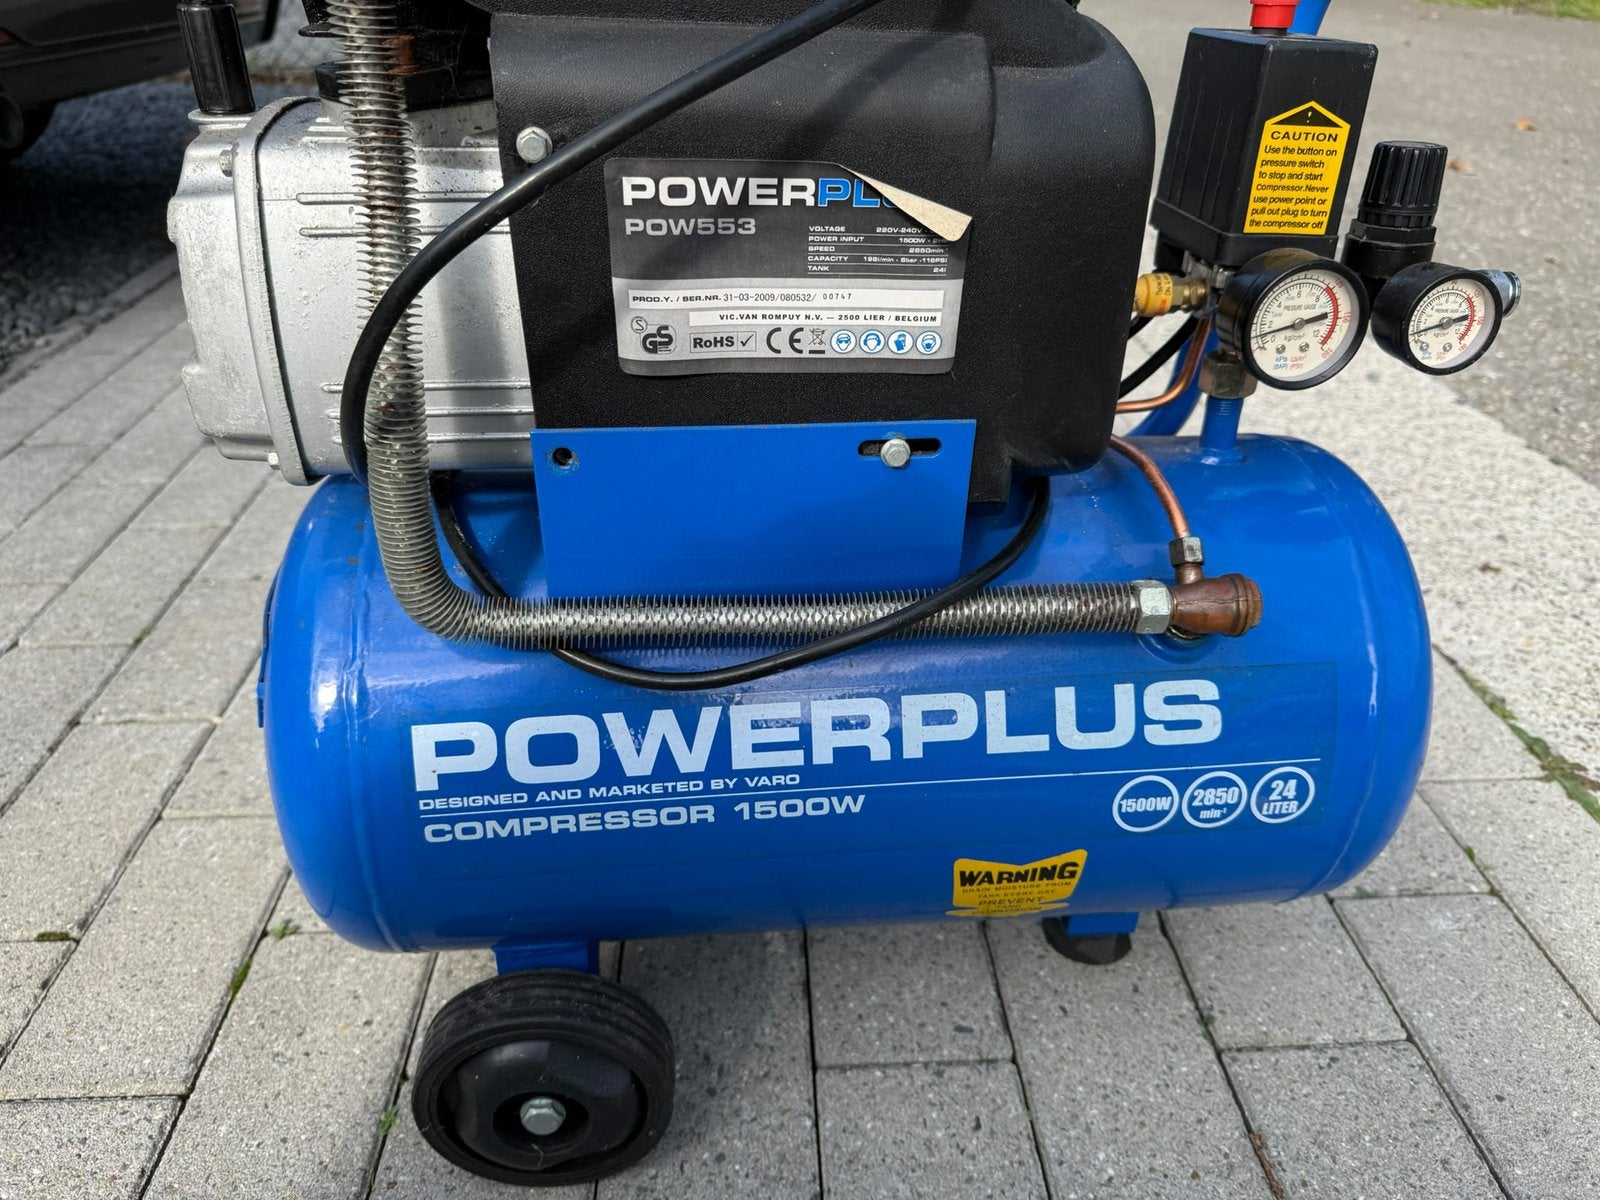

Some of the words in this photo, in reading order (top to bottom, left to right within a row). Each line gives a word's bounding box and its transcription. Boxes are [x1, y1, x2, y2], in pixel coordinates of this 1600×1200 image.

[1270, 131, 1338, 142] CAUTION
[1264, 145, 1280, 154] Use
[1282, 146, 1295, 154] the
[1297, 146, 1324, 156] button
[1260, 160, 1297, 170] pressure
[1298, 160, 1325, 168] switch
[1258, 171, 1267, 179] to
[1269, 172, 1286, 182] stop
[1287, 171, 1304, 180] and
[1304, 173, 1323, 181] start
[622, 176, 897, 208] POWERPL
[1269, 197, 1294, 207] power
[1294, 197, 1317, 207] point
[1251, 207, 1266, 217] pull
[1267, 208, 1280, 216] out
[1280, 208, 1299, 218] plug
[1300, 208, 1309, 217] to
[1310, 209, 1328, 217] turn
[625, 218, 757, 236] POW553
[1249, 219, 1261, 227] the
[1262, 220, 1310, 229] compressor
[1311, 220, 1324, 229] off
[693, 336, 735, 349] RoHS
[411, 679, 1222, 791] POWERPLUS
[419, 792, 528, 811] DESIGNED
[535, 788, 582, 802] AND
[589, 780, 704, 799] MARKETED
[710, 777, 738, 790] BY
[743, 773, 801, 787] VARO
[1192, 786, 1240, 806] 2850
[1269, 779, 1298, 801] 24
[1120, 796, 1172, 813] 1500W
[1262, 801, 1299, 815] LITER
[423, 804, 715, 843] COMPRESSOR
[733, 794, 866, 821] 1500W
[959, 862, 1079, 887] WARNING
[978, 896, 1044, 906] PREVENT
